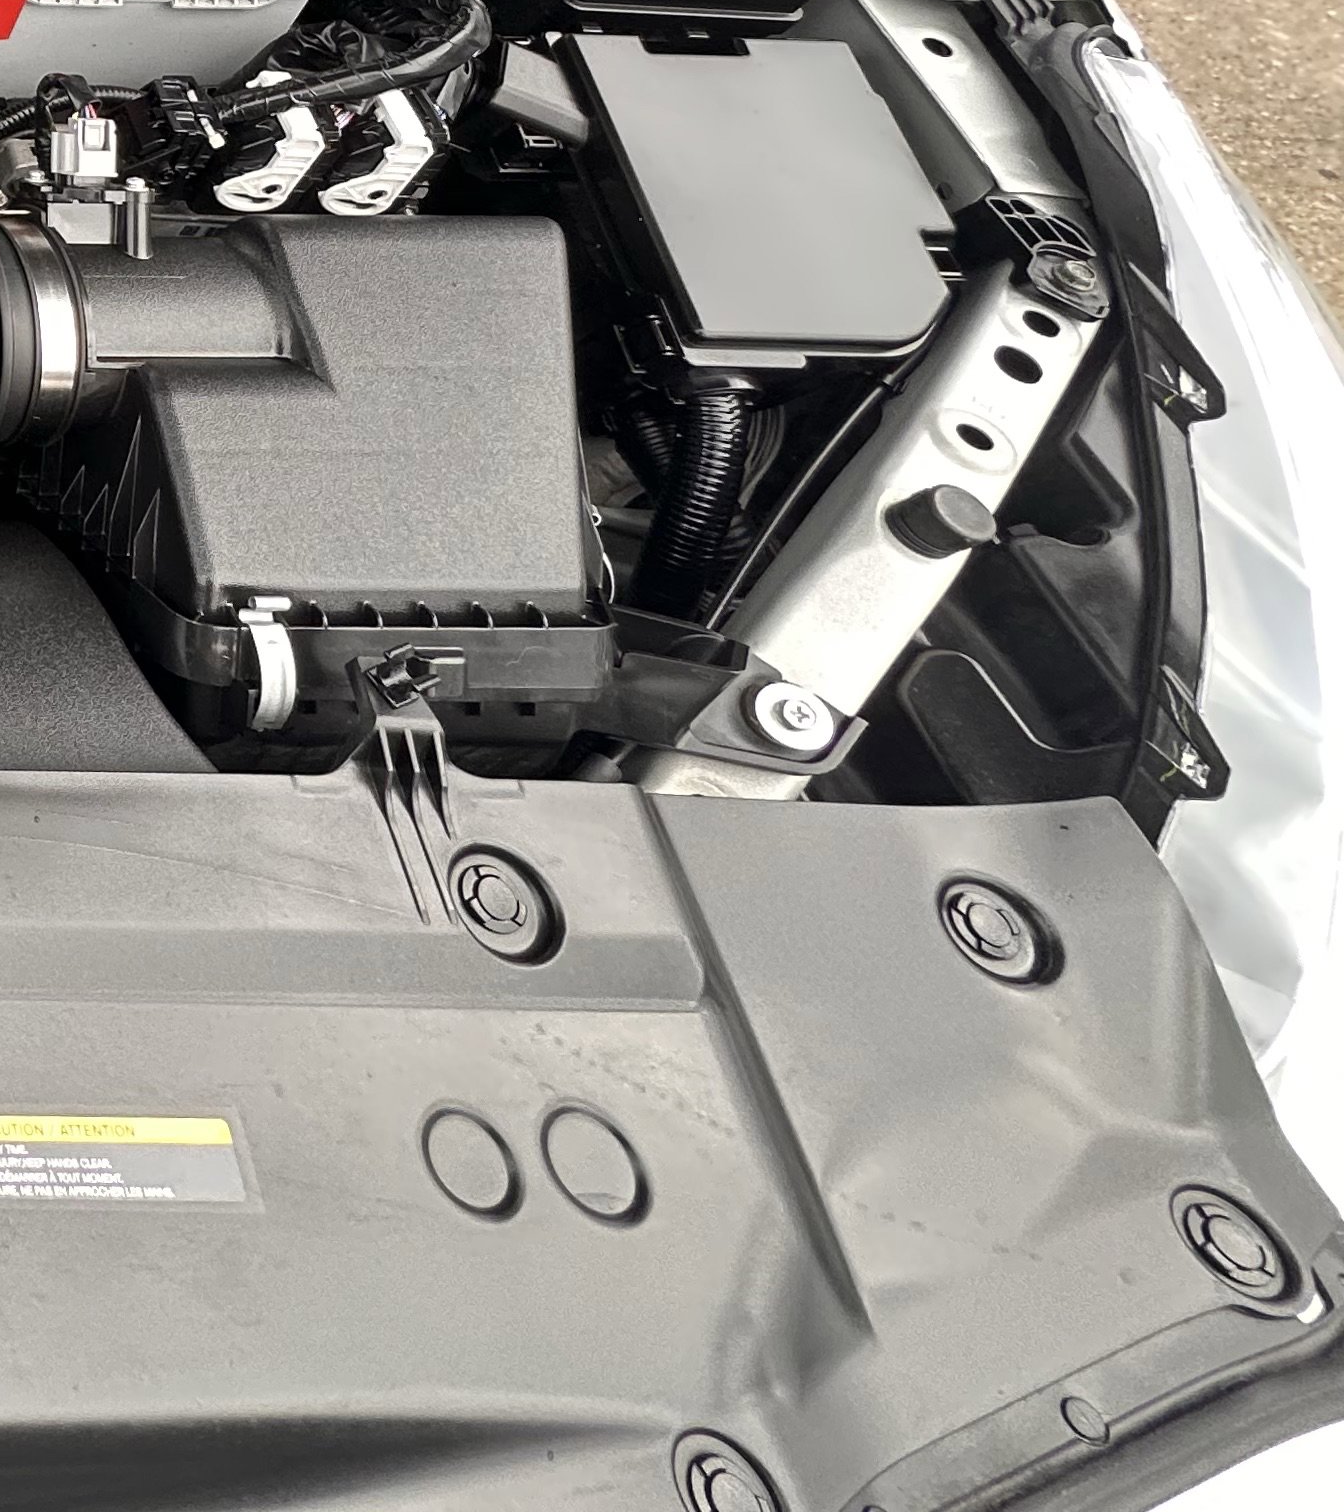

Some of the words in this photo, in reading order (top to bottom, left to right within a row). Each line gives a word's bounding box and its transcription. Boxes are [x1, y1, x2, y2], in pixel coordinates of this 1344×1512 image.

[60, 1123, 136, 1138] ATTENTION
[46, 1157, 79, 1167] HANDS
[56, 1172, 81, 1182] TOUT
[33, 1185, 53, 1196] PAS
[67, 1185, 125, 1196] APPROCHER
